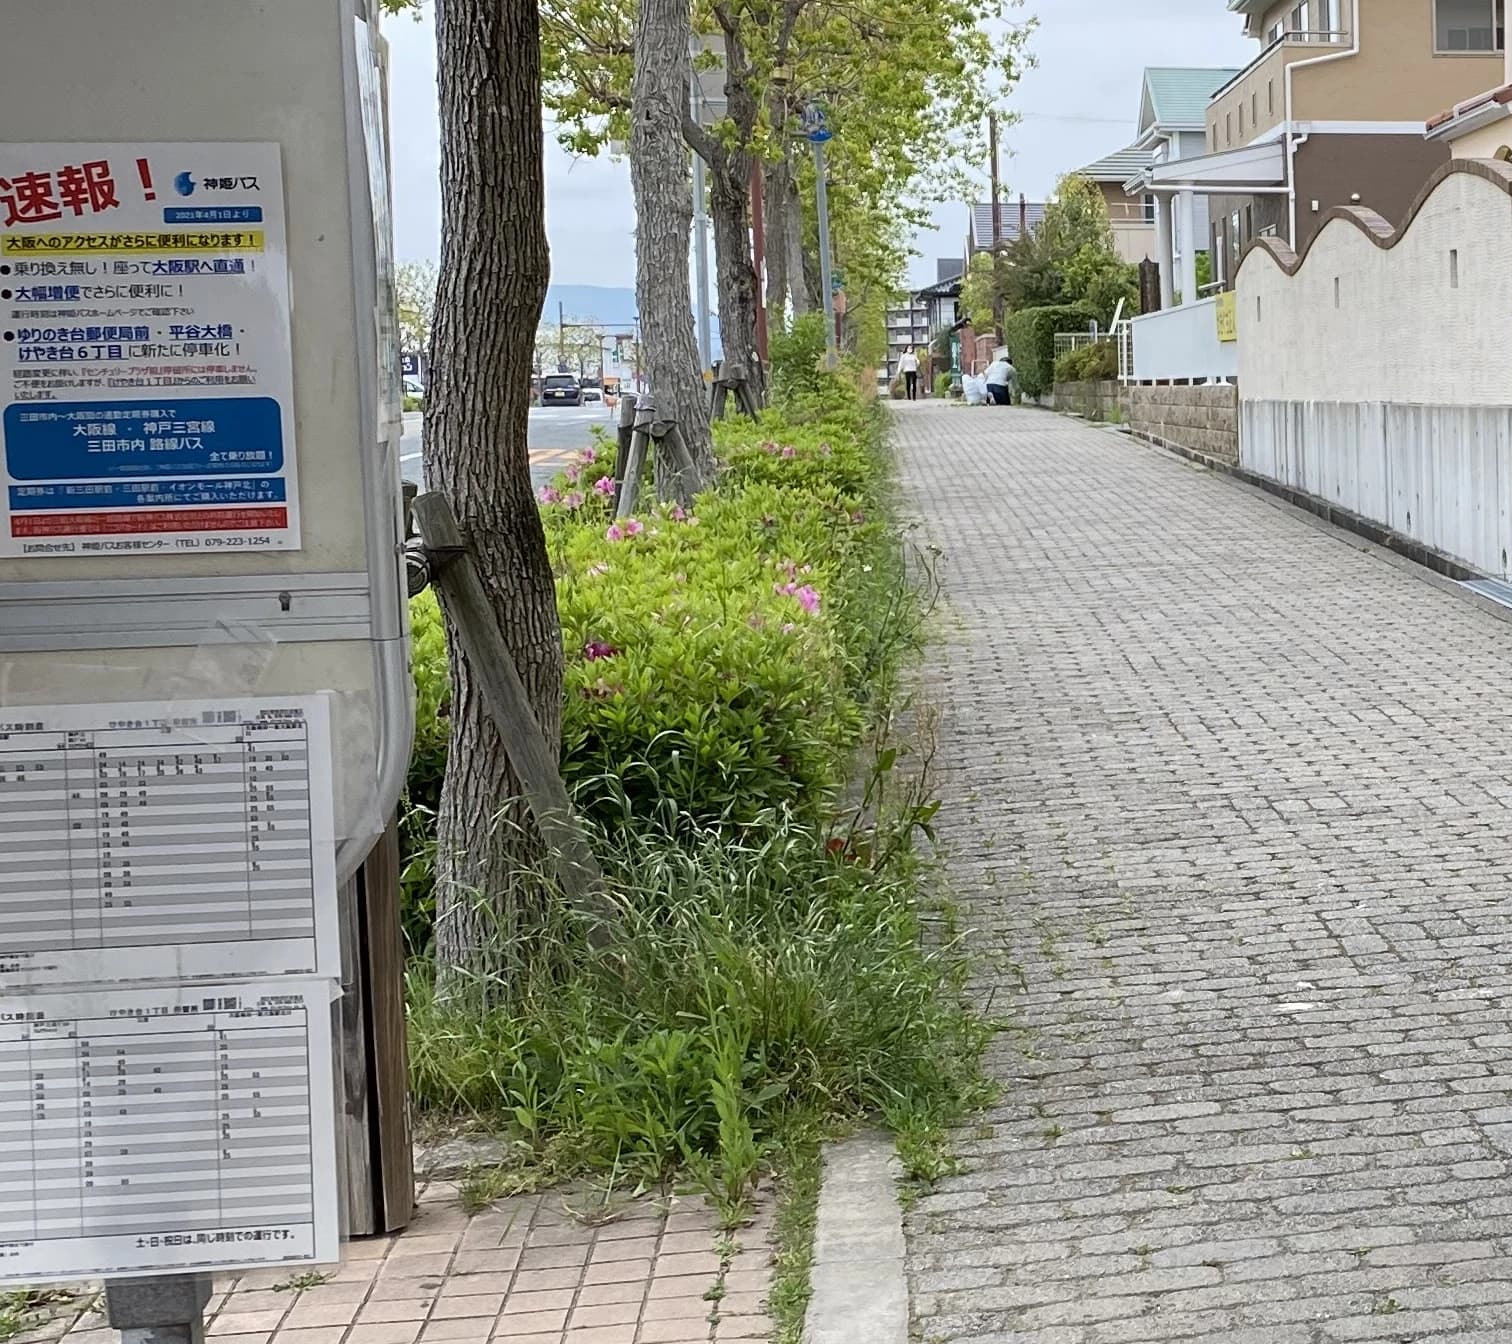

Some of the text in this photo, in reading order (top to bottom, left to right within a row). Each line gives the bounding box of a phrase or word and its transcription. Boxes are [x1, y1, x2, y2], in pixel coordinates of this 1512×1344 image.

[203, 176, 260, 191] 神姫バス
[205, 536, 270, 547] 079-223-1254
